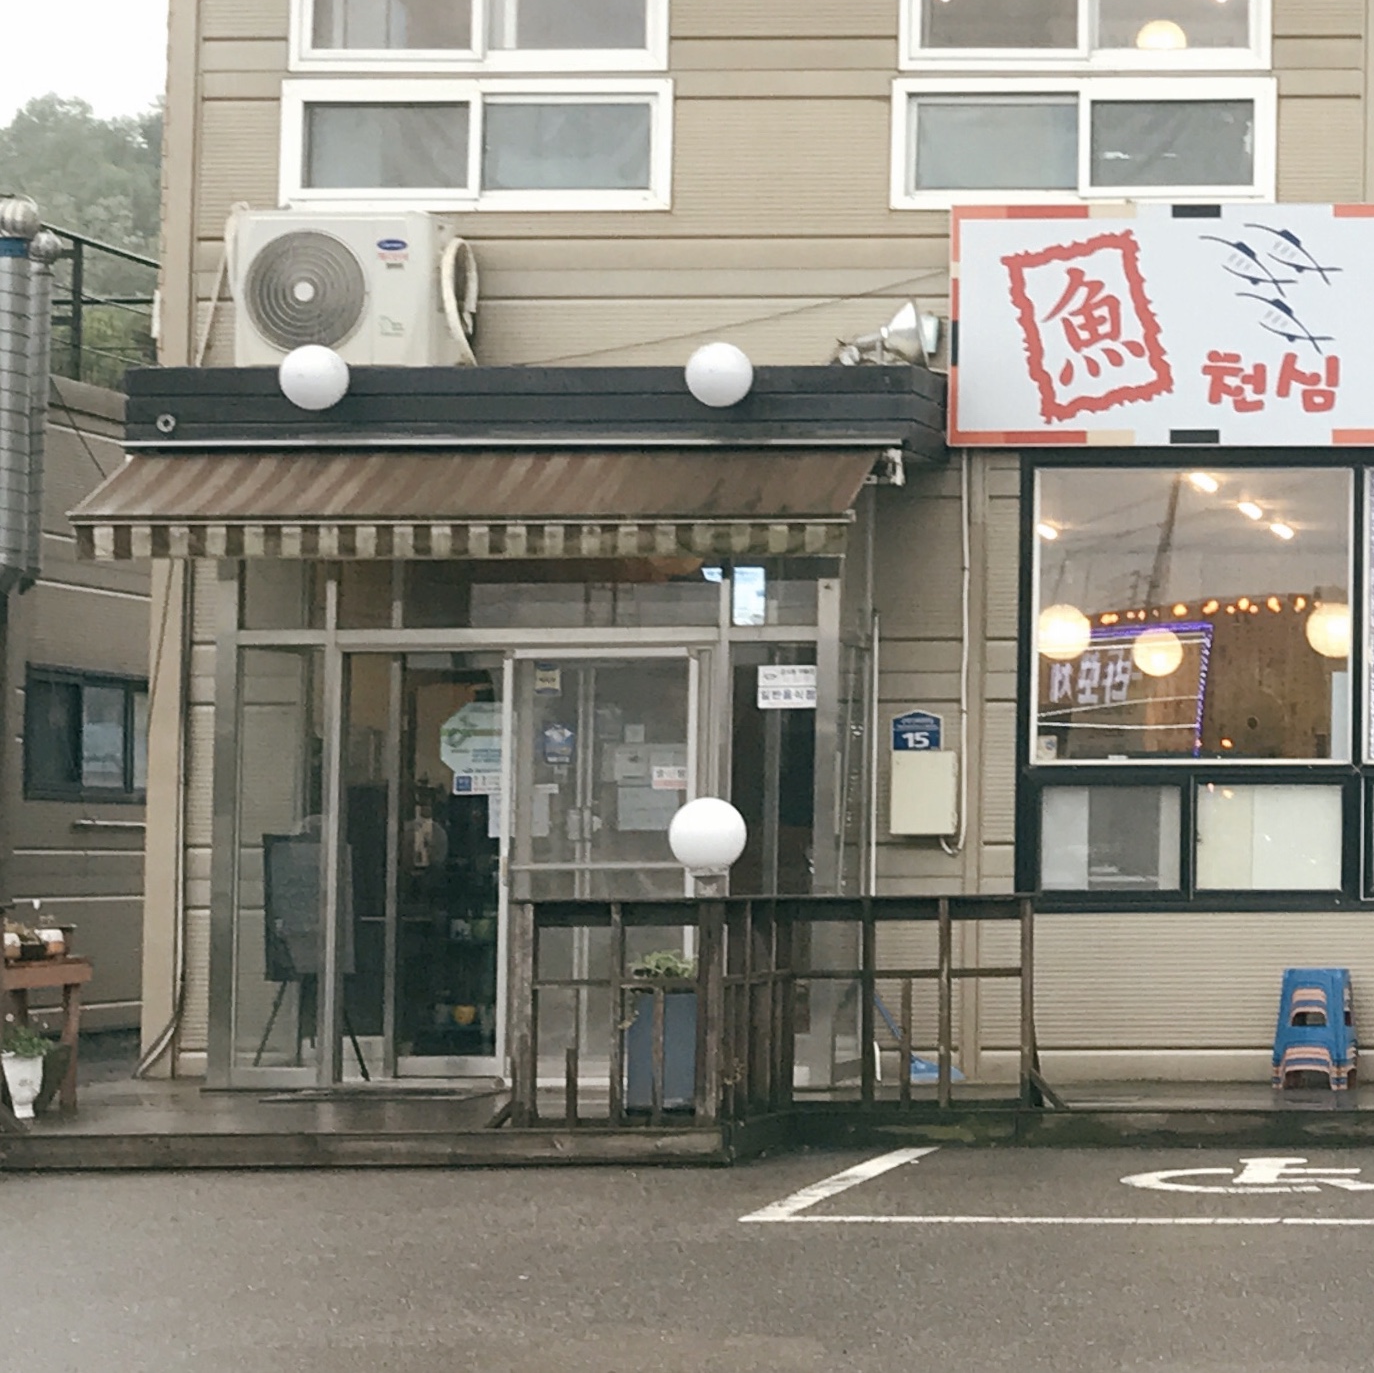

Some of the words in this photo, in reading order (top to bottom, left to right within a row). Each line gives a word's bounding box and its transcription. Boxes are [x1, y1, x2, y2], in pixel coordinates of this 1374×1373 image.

[1042, 264, 1148, 387] 魚
[1201, 349, 1341, 413] 천심
[902, 731, 930, 748] 15
